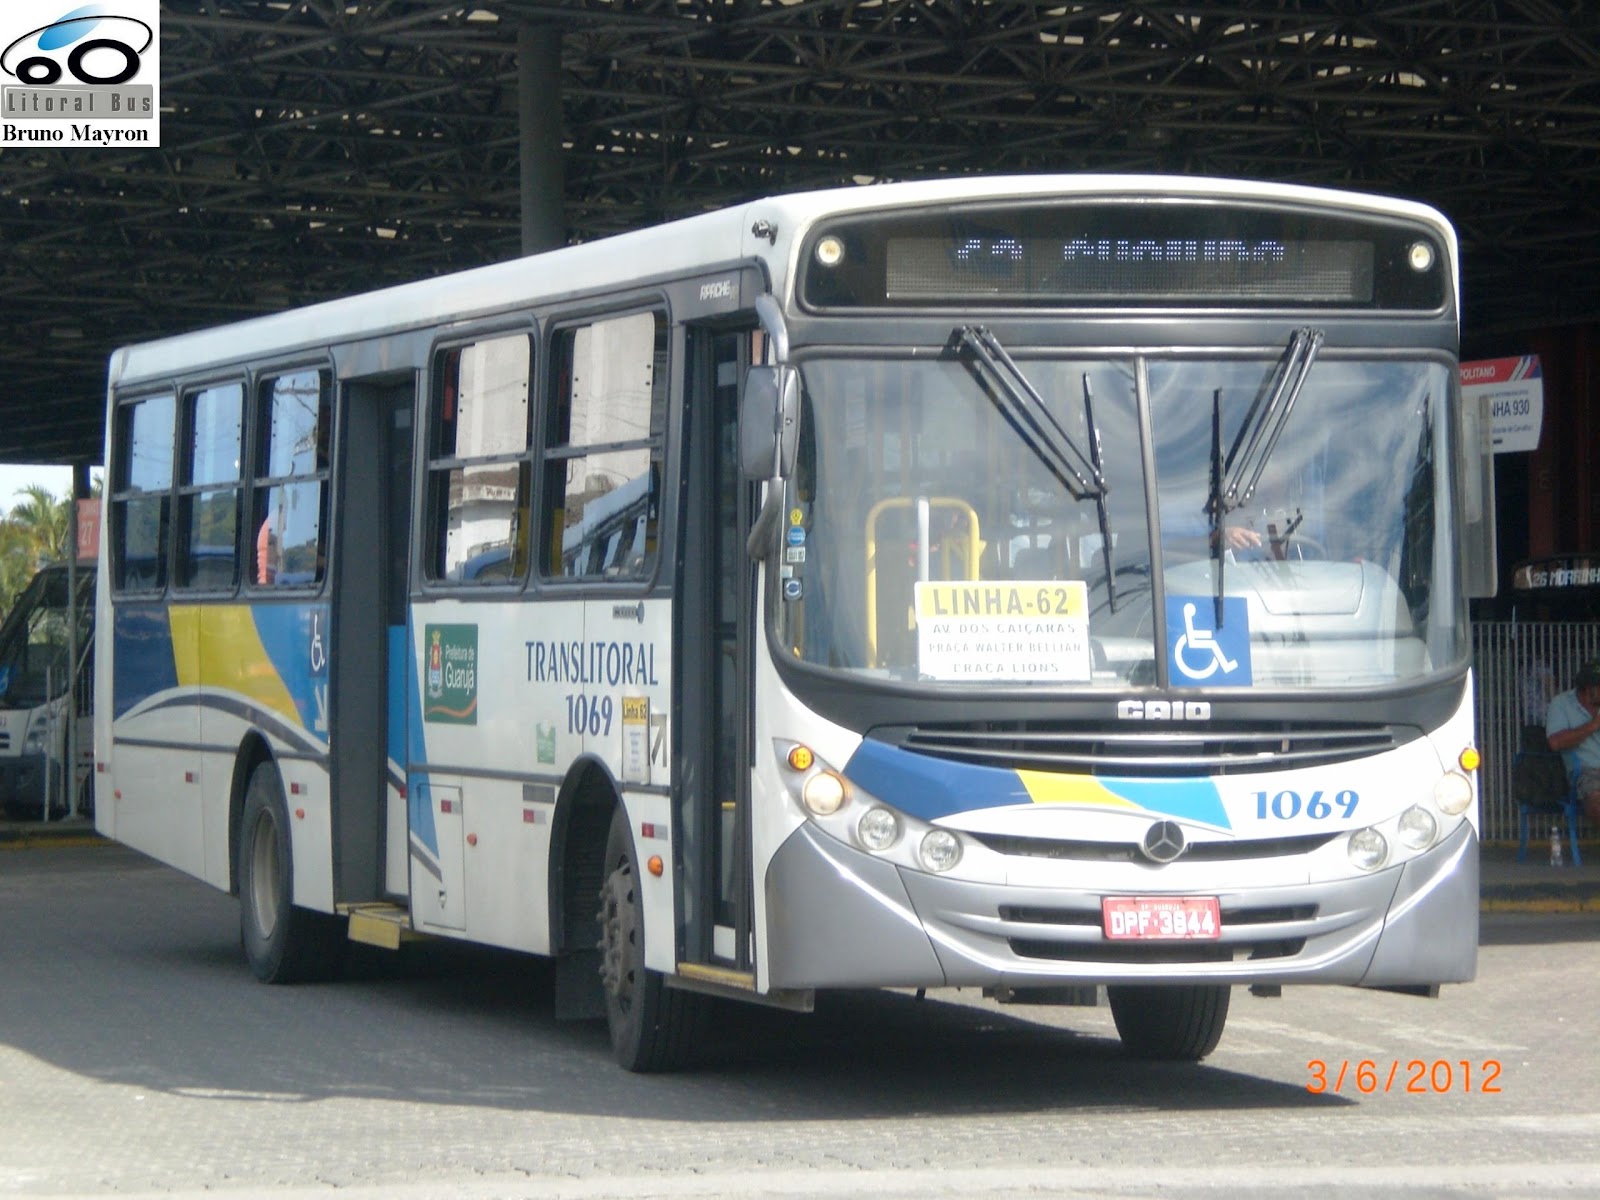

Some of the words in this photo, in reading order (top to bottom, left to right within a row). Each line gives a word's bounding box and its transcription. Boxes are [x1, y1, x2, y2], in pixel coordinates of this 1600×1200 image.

[1512, 399, 1530, 415] 930
[959, 624, 990, 634] DOS
[997, 623, 1075, 637] CAIÇARAS
[929, 643, 969, 654] PRAÇA
[975, 643, 1023, 653] WALTER
[525, 641, 659, 686] TRANSLITORAL
[1012, 663, 1060, 673] LIONS
[445, 662, 475, 695] Guarujá
[565, 694, 613, 737] 1069
[1117, 700, 1211, 720] CAIO
[1250, 789, 1360, 820] 1069
